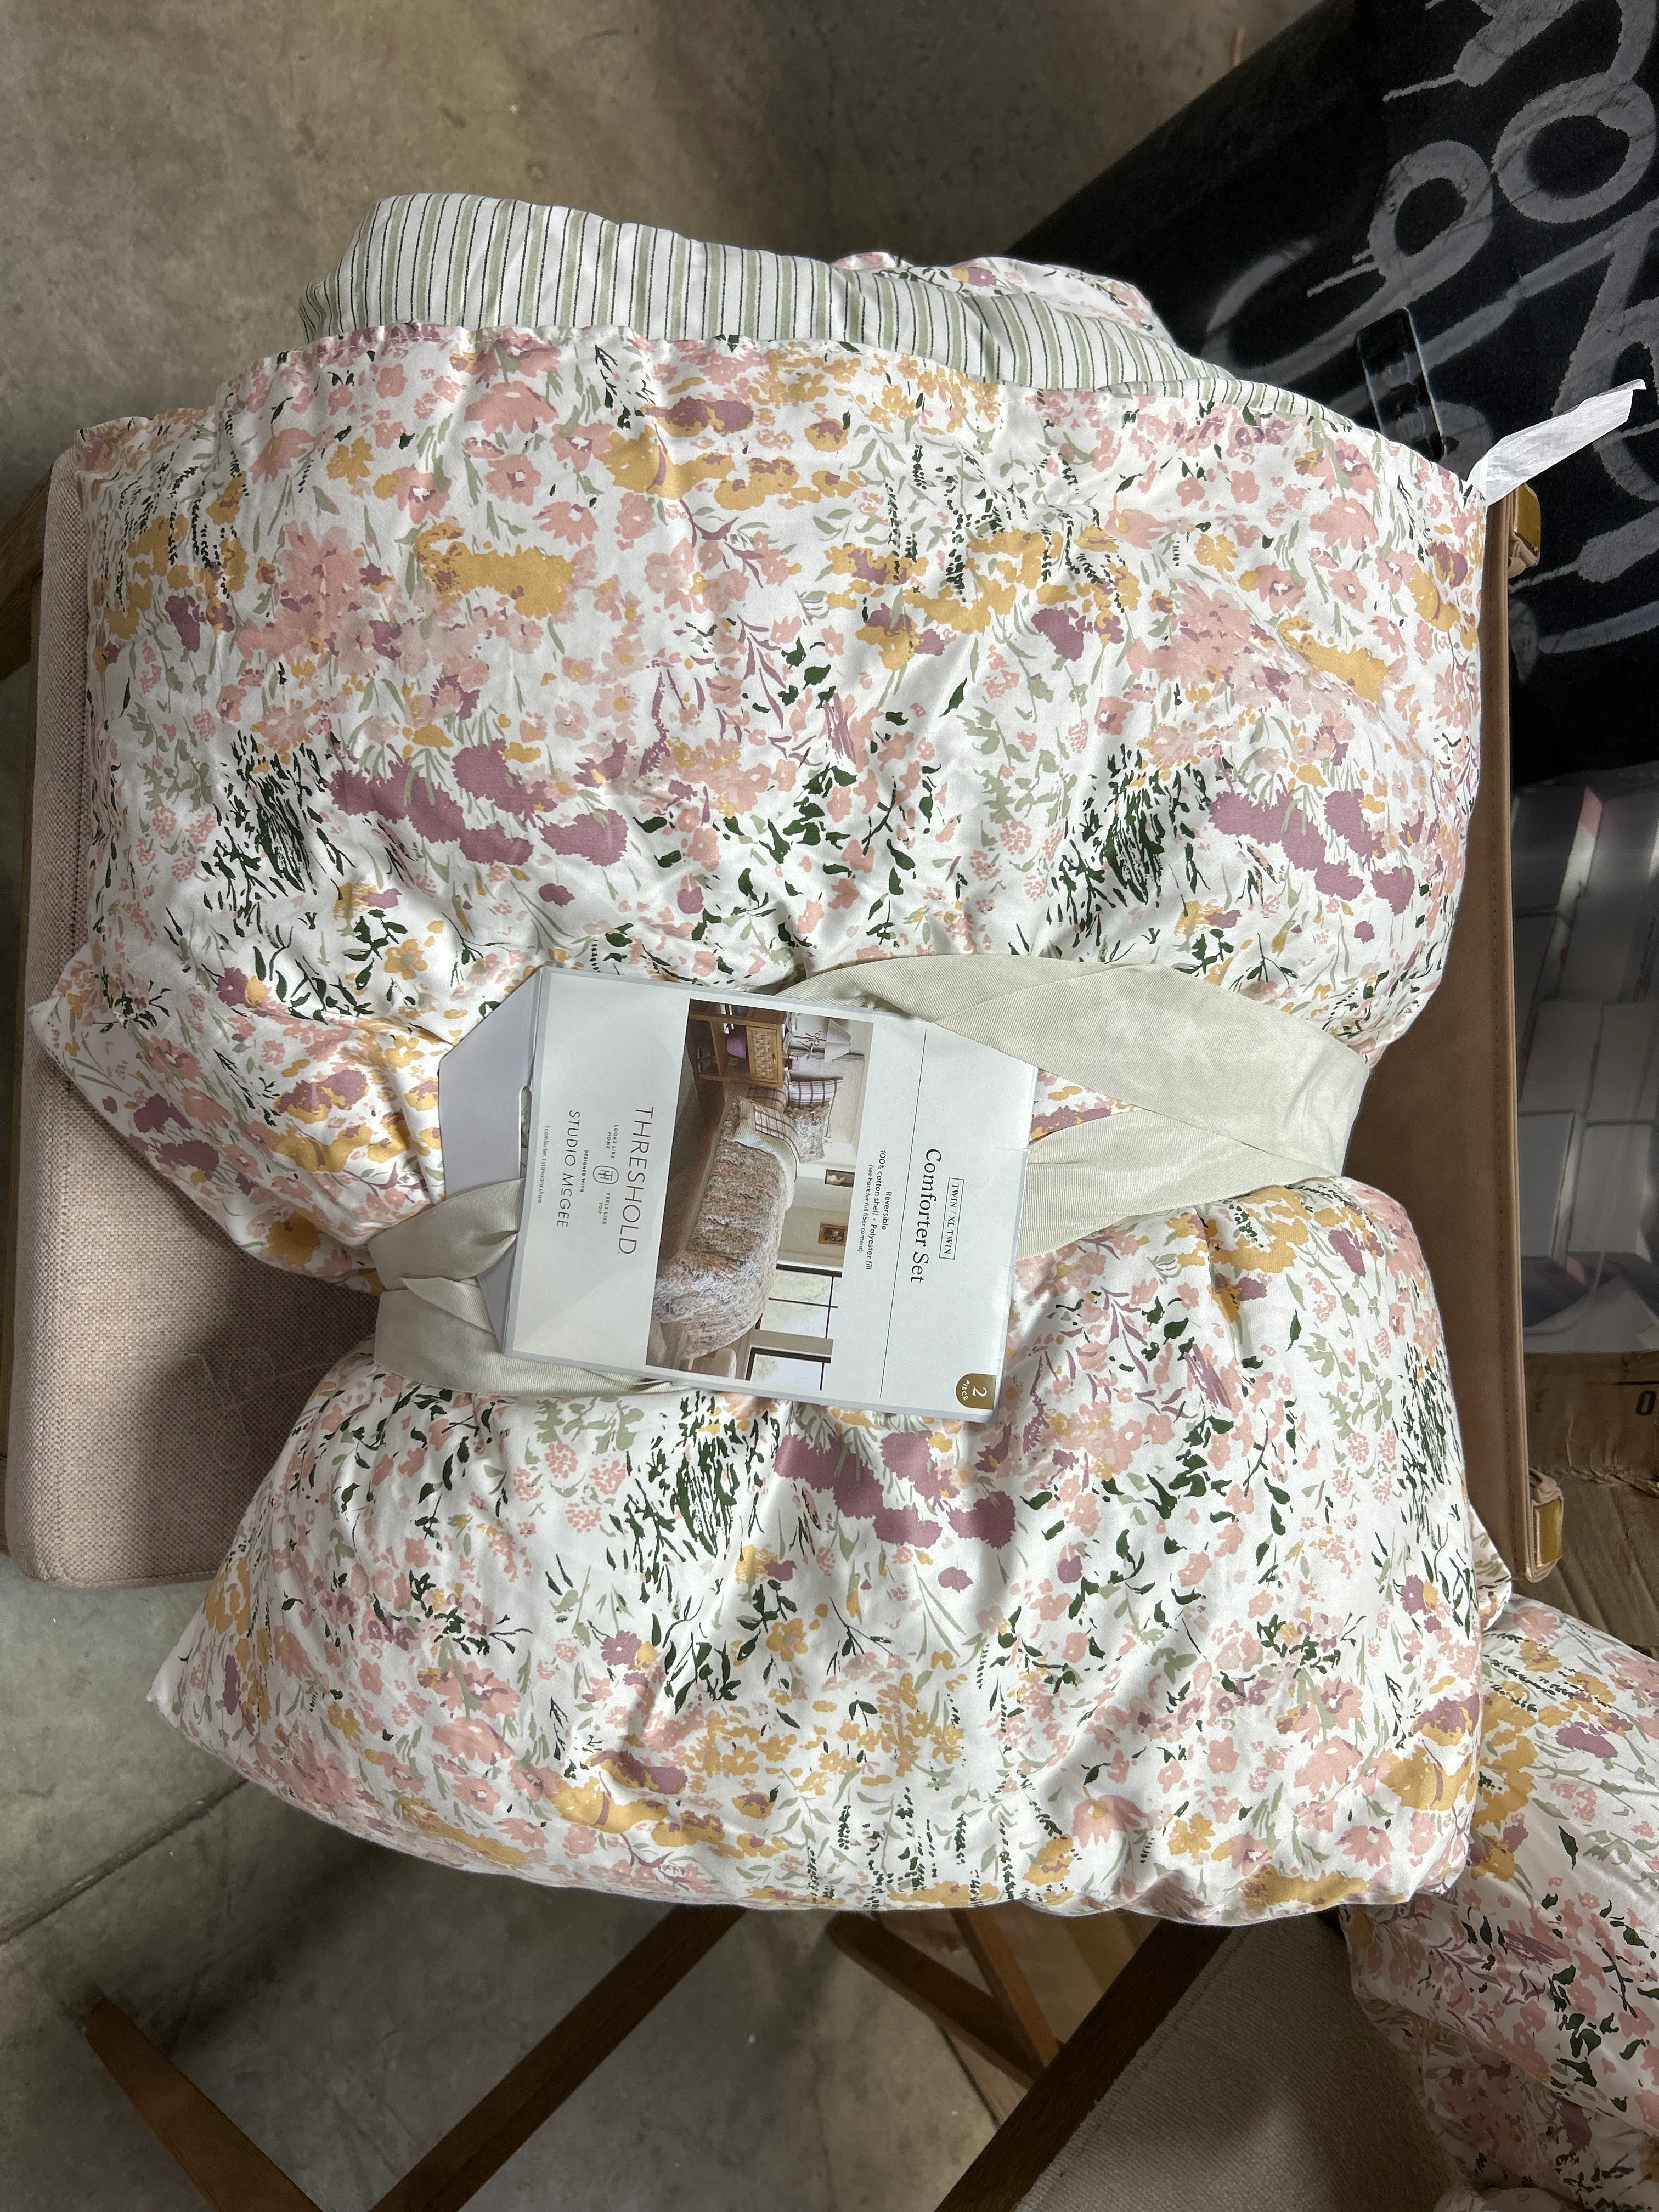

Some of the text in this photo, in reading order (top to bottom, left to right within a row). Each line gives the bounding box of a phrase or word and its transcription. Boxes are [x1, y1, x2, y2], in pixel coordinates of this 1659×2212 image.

[565, 1110, 580, 1166] STUDIO
[619, 1107, 653, 1254] THRESHOLD
[874, 1171, 883, 1196] cotton
[950, 1183, 959, 1207] TWIN
[882, 1192, 892, 1230] Reversible
[911, 1149, 941, 1283] Comforter Set
[947, 1216, 955, 1228] XL
[866, 1224, 877, 1259] Polyester
[944, 1230, 953, 1255] TWIN
[961, 1379, 970, 1401] PIECE
[972, 1386, 988, 1397] 2
